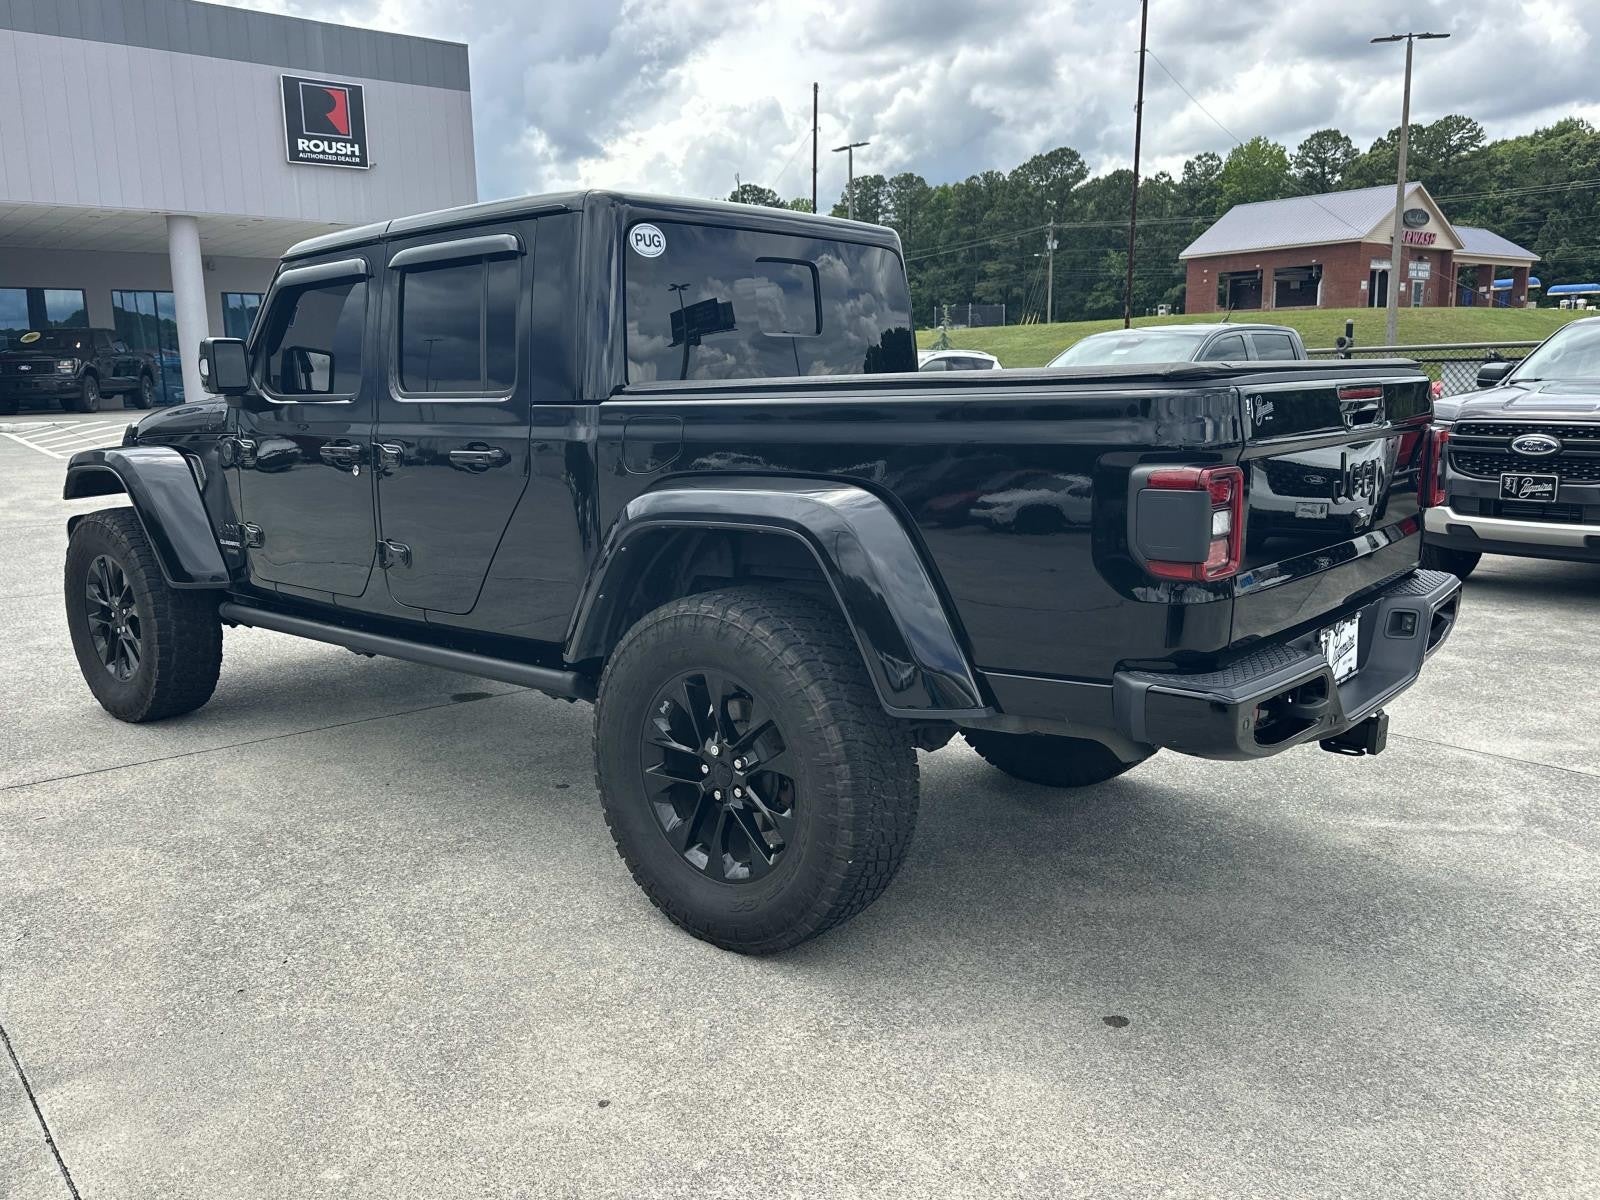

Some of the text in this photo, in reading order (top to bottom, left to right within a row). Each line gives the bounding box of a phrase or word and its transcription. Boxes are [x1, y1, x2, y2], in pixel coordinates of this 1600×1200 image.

[297, 138, 360, 156] ROUSH
[299, 152, 361, 163] AUTHORIZED DEALER
[634, 232, 662, 248] PUG
